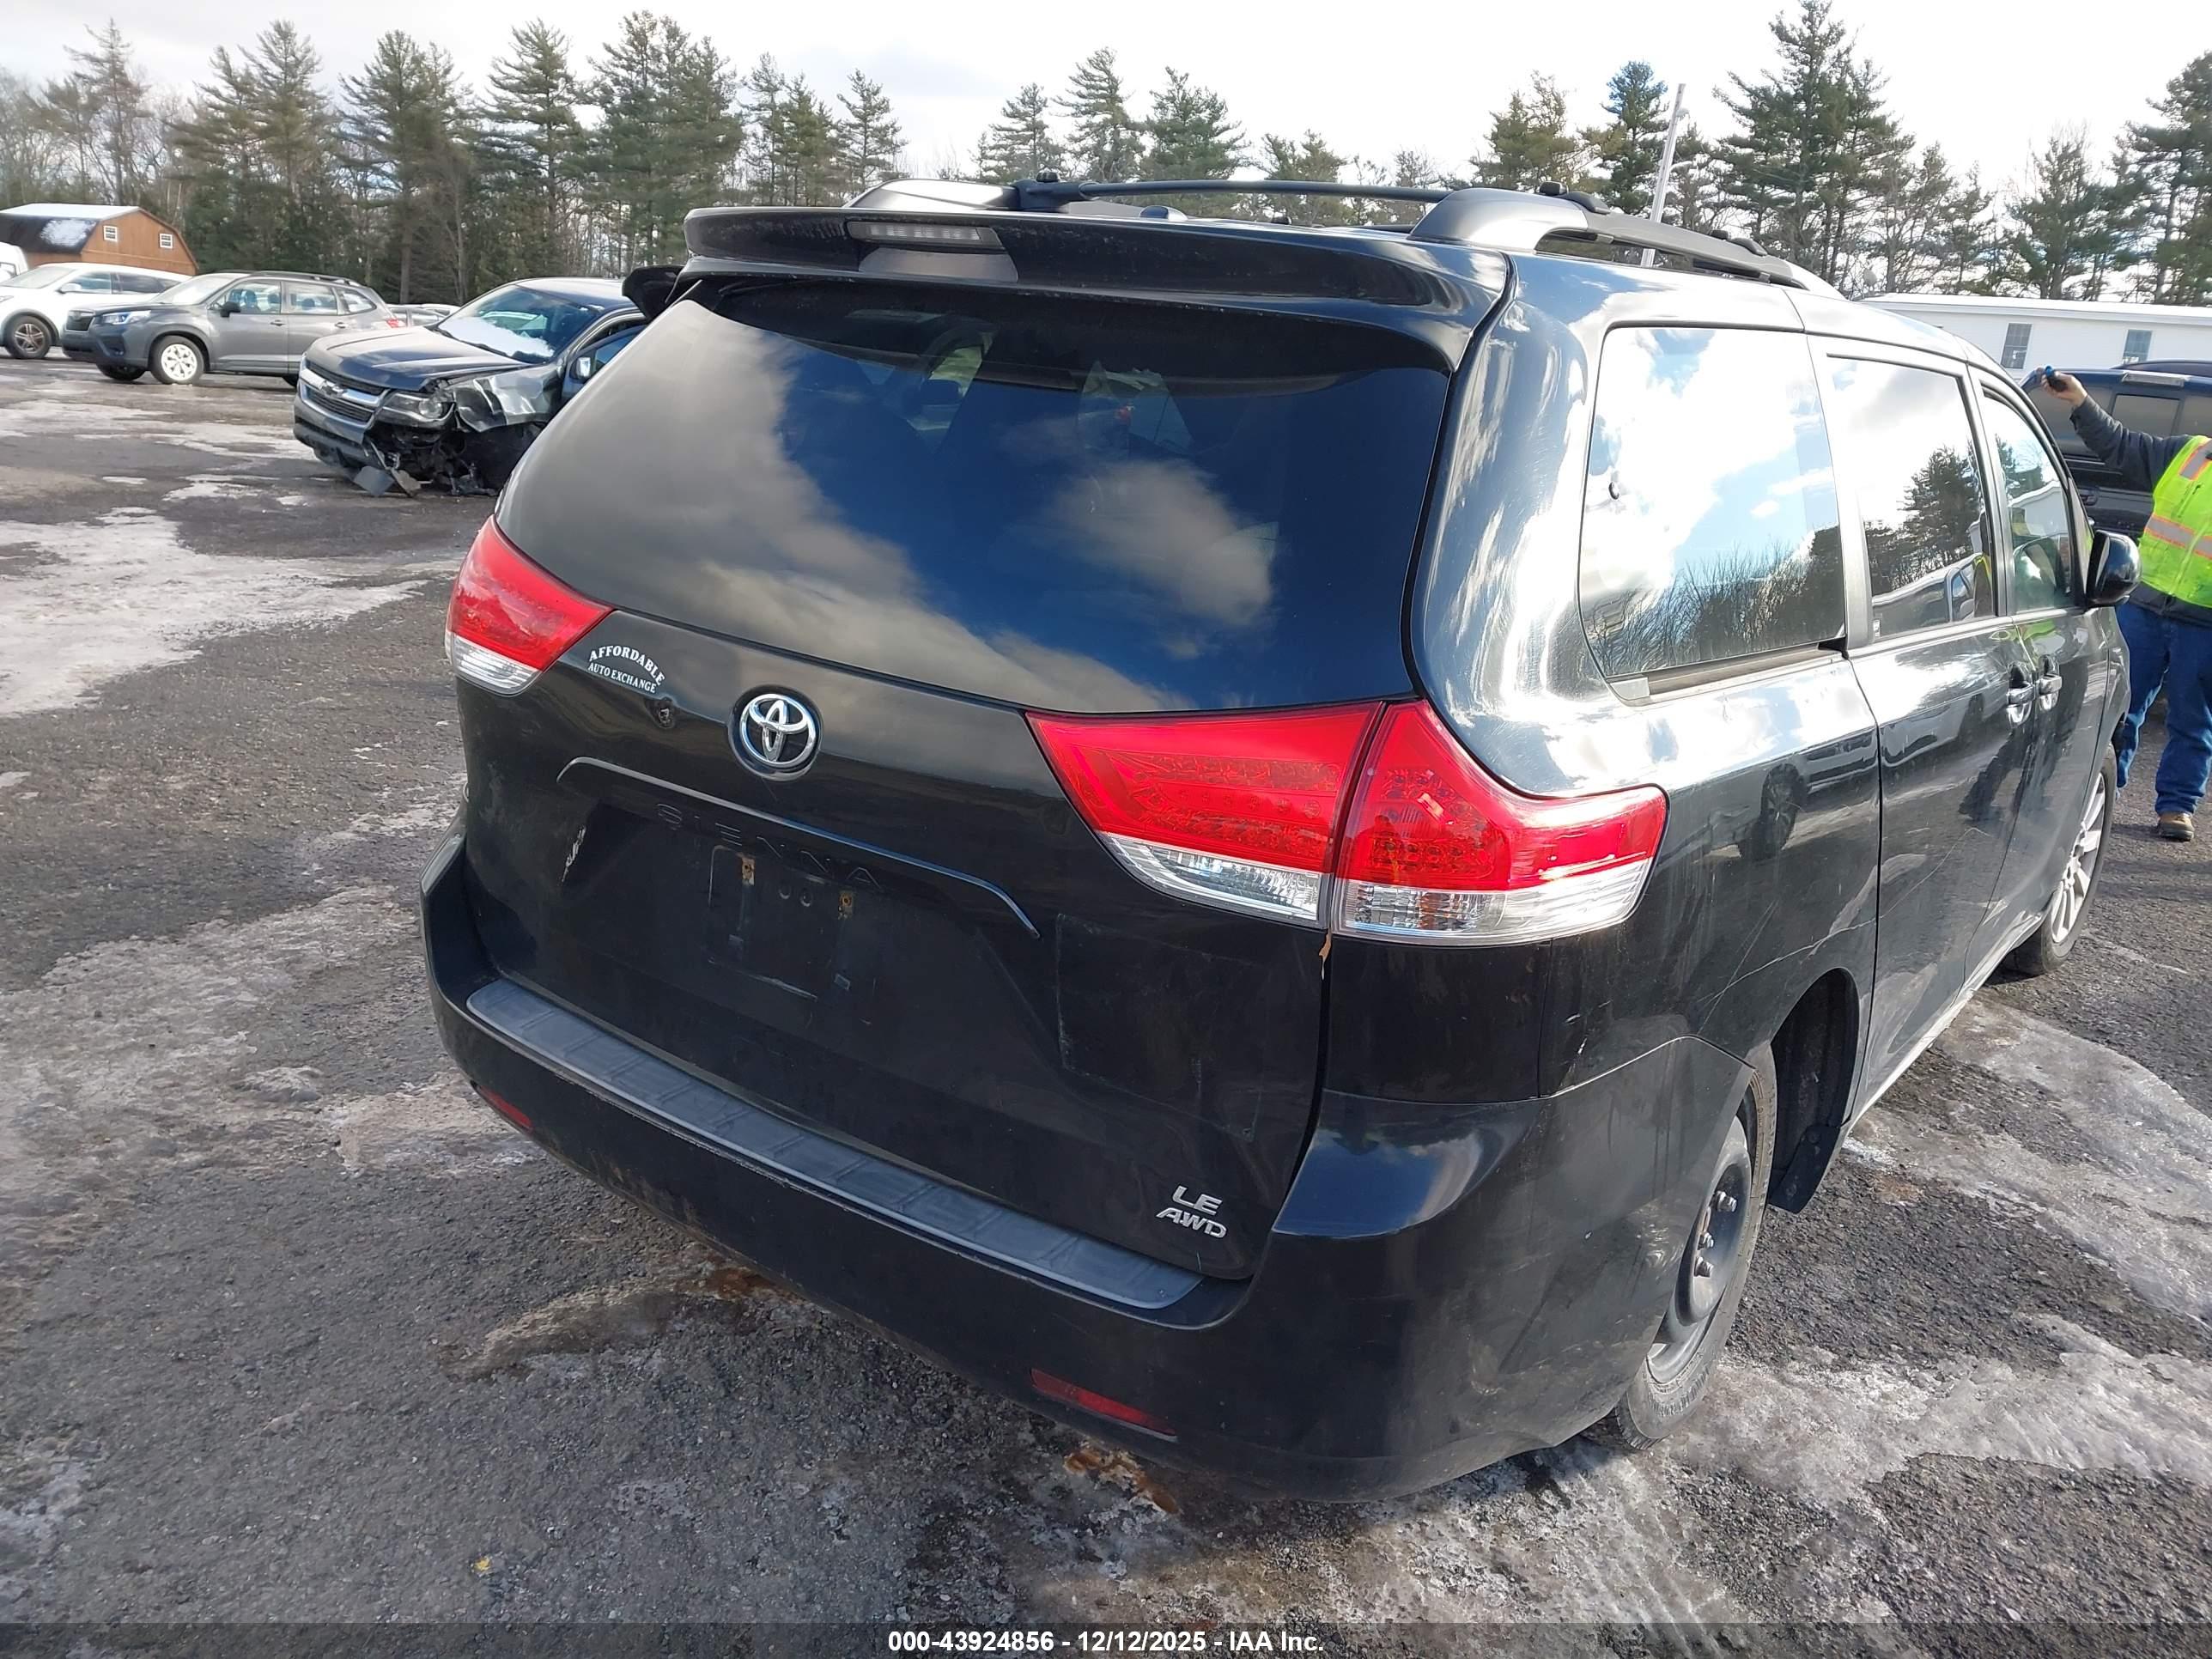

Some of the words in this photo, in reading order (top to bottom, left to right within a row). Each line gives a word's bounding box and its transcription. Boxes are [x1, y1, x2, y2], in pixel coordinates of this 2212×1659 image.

[587, 662, 611, 677] AUTO
[611, 669, 656, 694] EXCHANGE
[589, 645, 665, 686] AFFORDABLE
[656, 803, 884, 891] SENNA
[1172, 1185, 1223, 1216] LE
[1156, 1207, 1227, 1238] AWD
